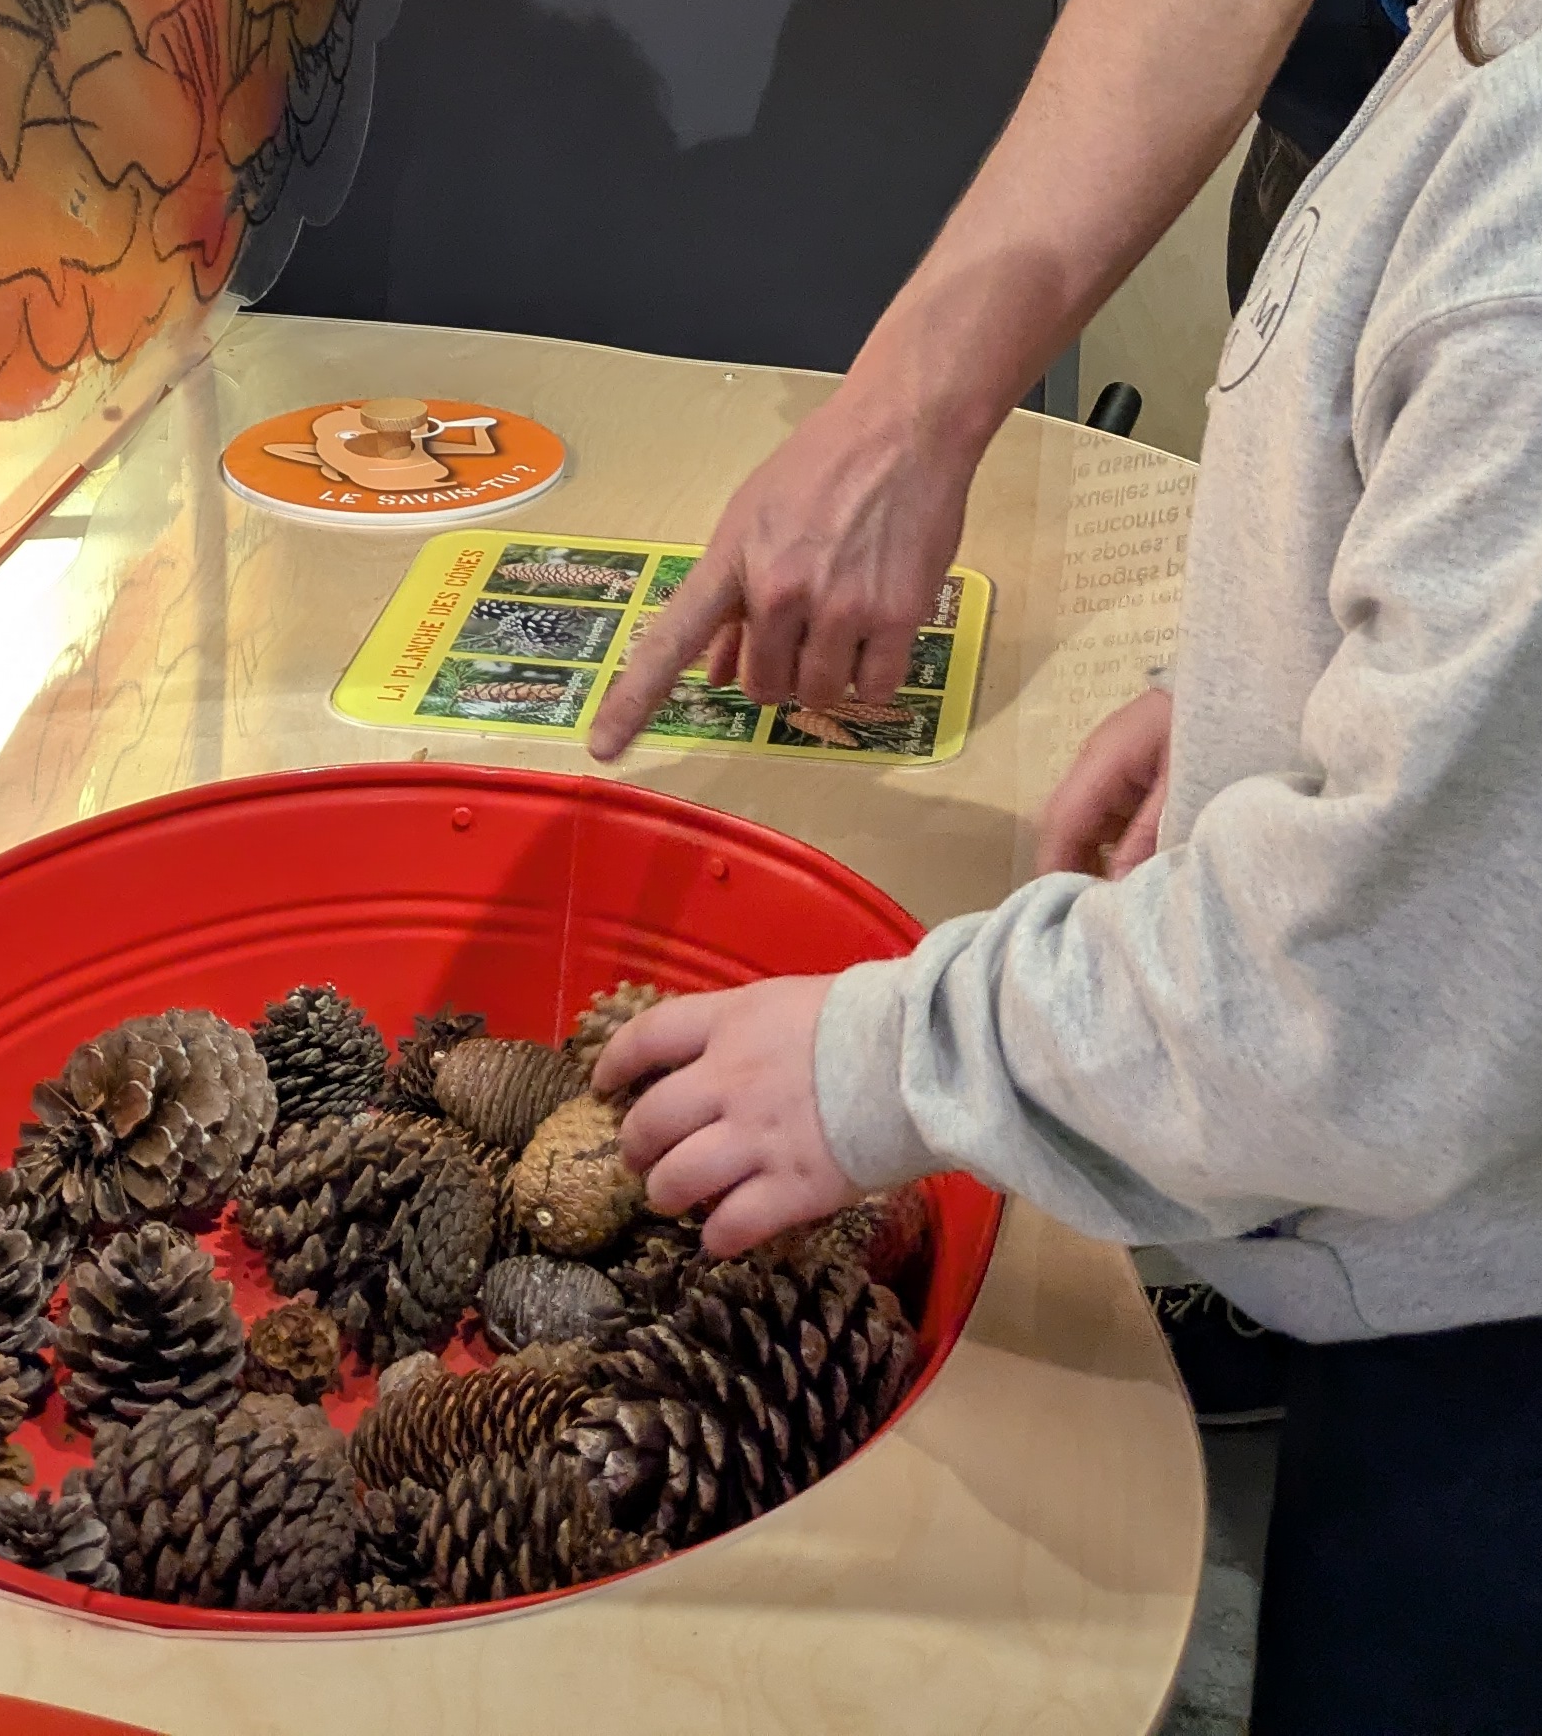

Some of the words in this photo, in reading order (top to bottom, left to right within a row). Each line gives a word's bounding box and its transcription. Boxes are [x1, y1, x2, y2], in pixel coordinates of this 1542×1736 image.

[318, 490, 362, 505] LE
[376, 472, 521, 506] SAVAIS-TU
[443, 548, 485, 587] CÔNES
[426, 591, 461, 616] DES
[389, 619, 445, 678] PLANCHE
[376, 684, 409, 702] LA
